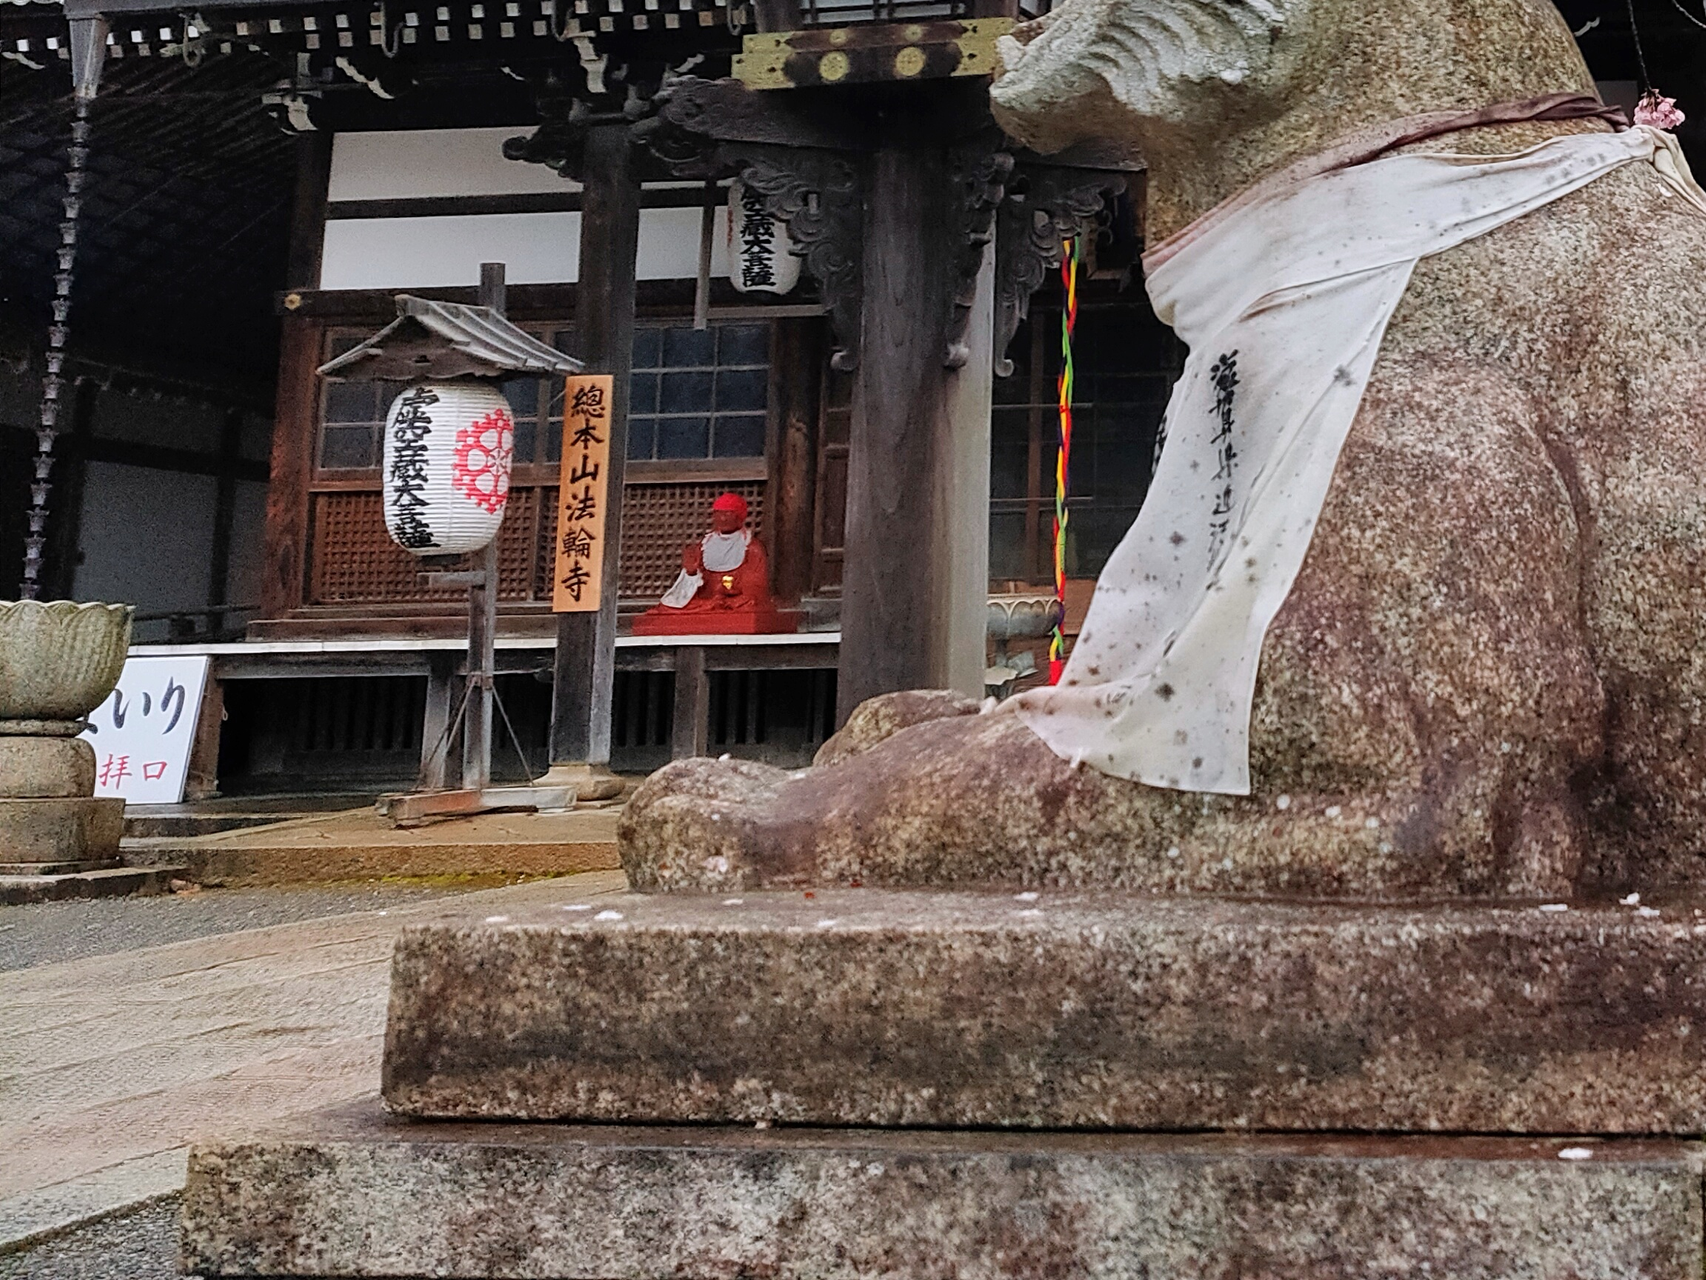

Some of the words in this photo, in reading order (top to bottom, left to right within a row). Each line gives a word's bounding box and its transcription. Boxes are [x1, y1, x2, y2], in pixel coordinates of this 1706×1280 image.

[561, 385, 605, 602] 總本山法輪寺
[87, 676, 185, 735] いり
